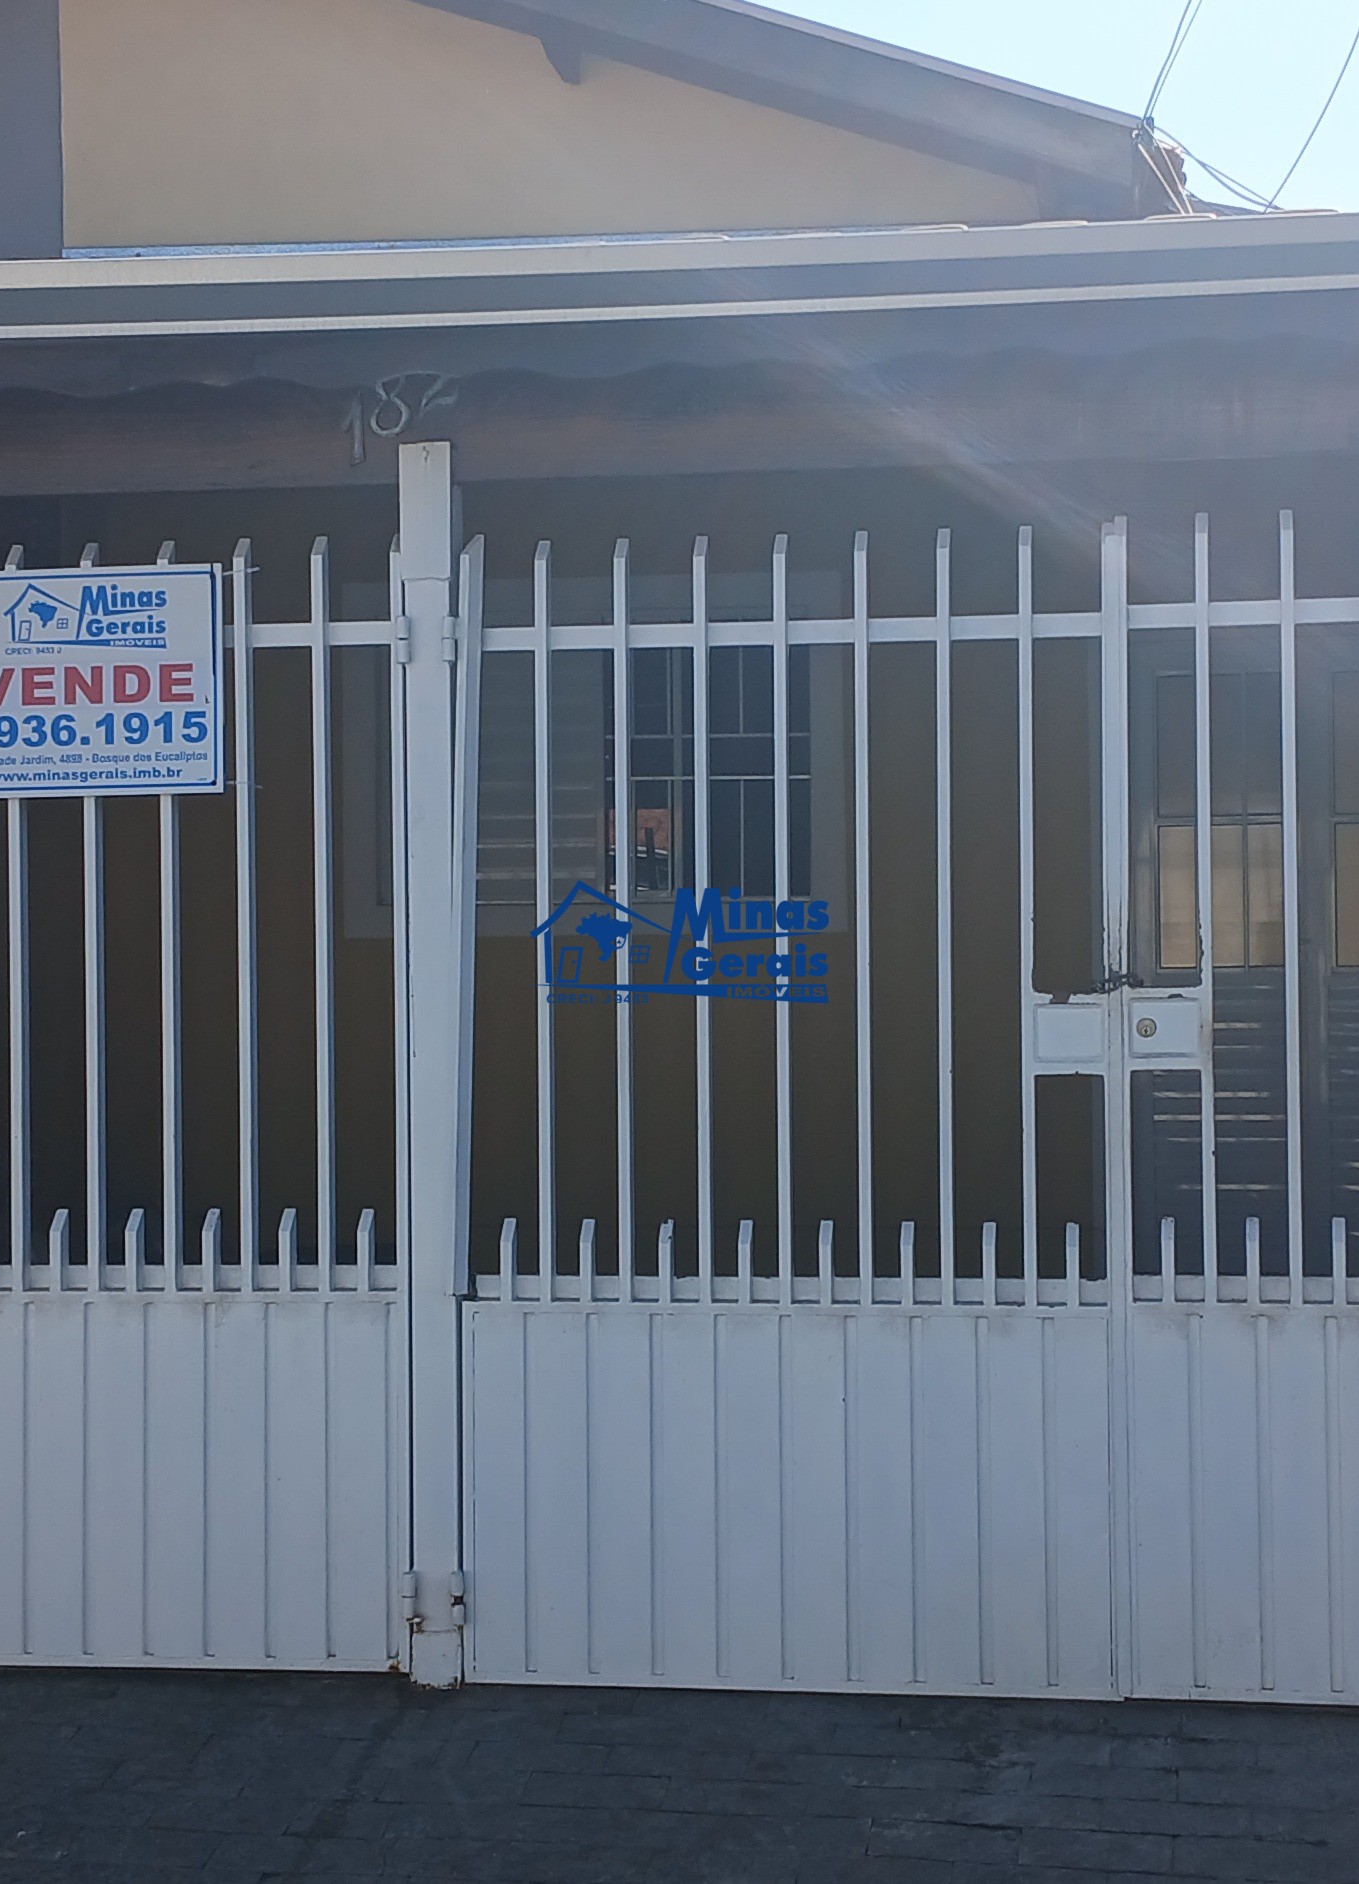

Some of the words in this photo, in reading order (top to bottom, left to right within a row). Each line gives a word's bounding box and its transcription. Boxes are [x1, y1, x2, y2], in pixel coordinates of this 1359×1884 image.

[80, 583, 168, 616] Minas
[85, 614, 167, 638] Gerais
[92, 753, 130, 764] Bosque
[133, 753, 152, 762] dos
